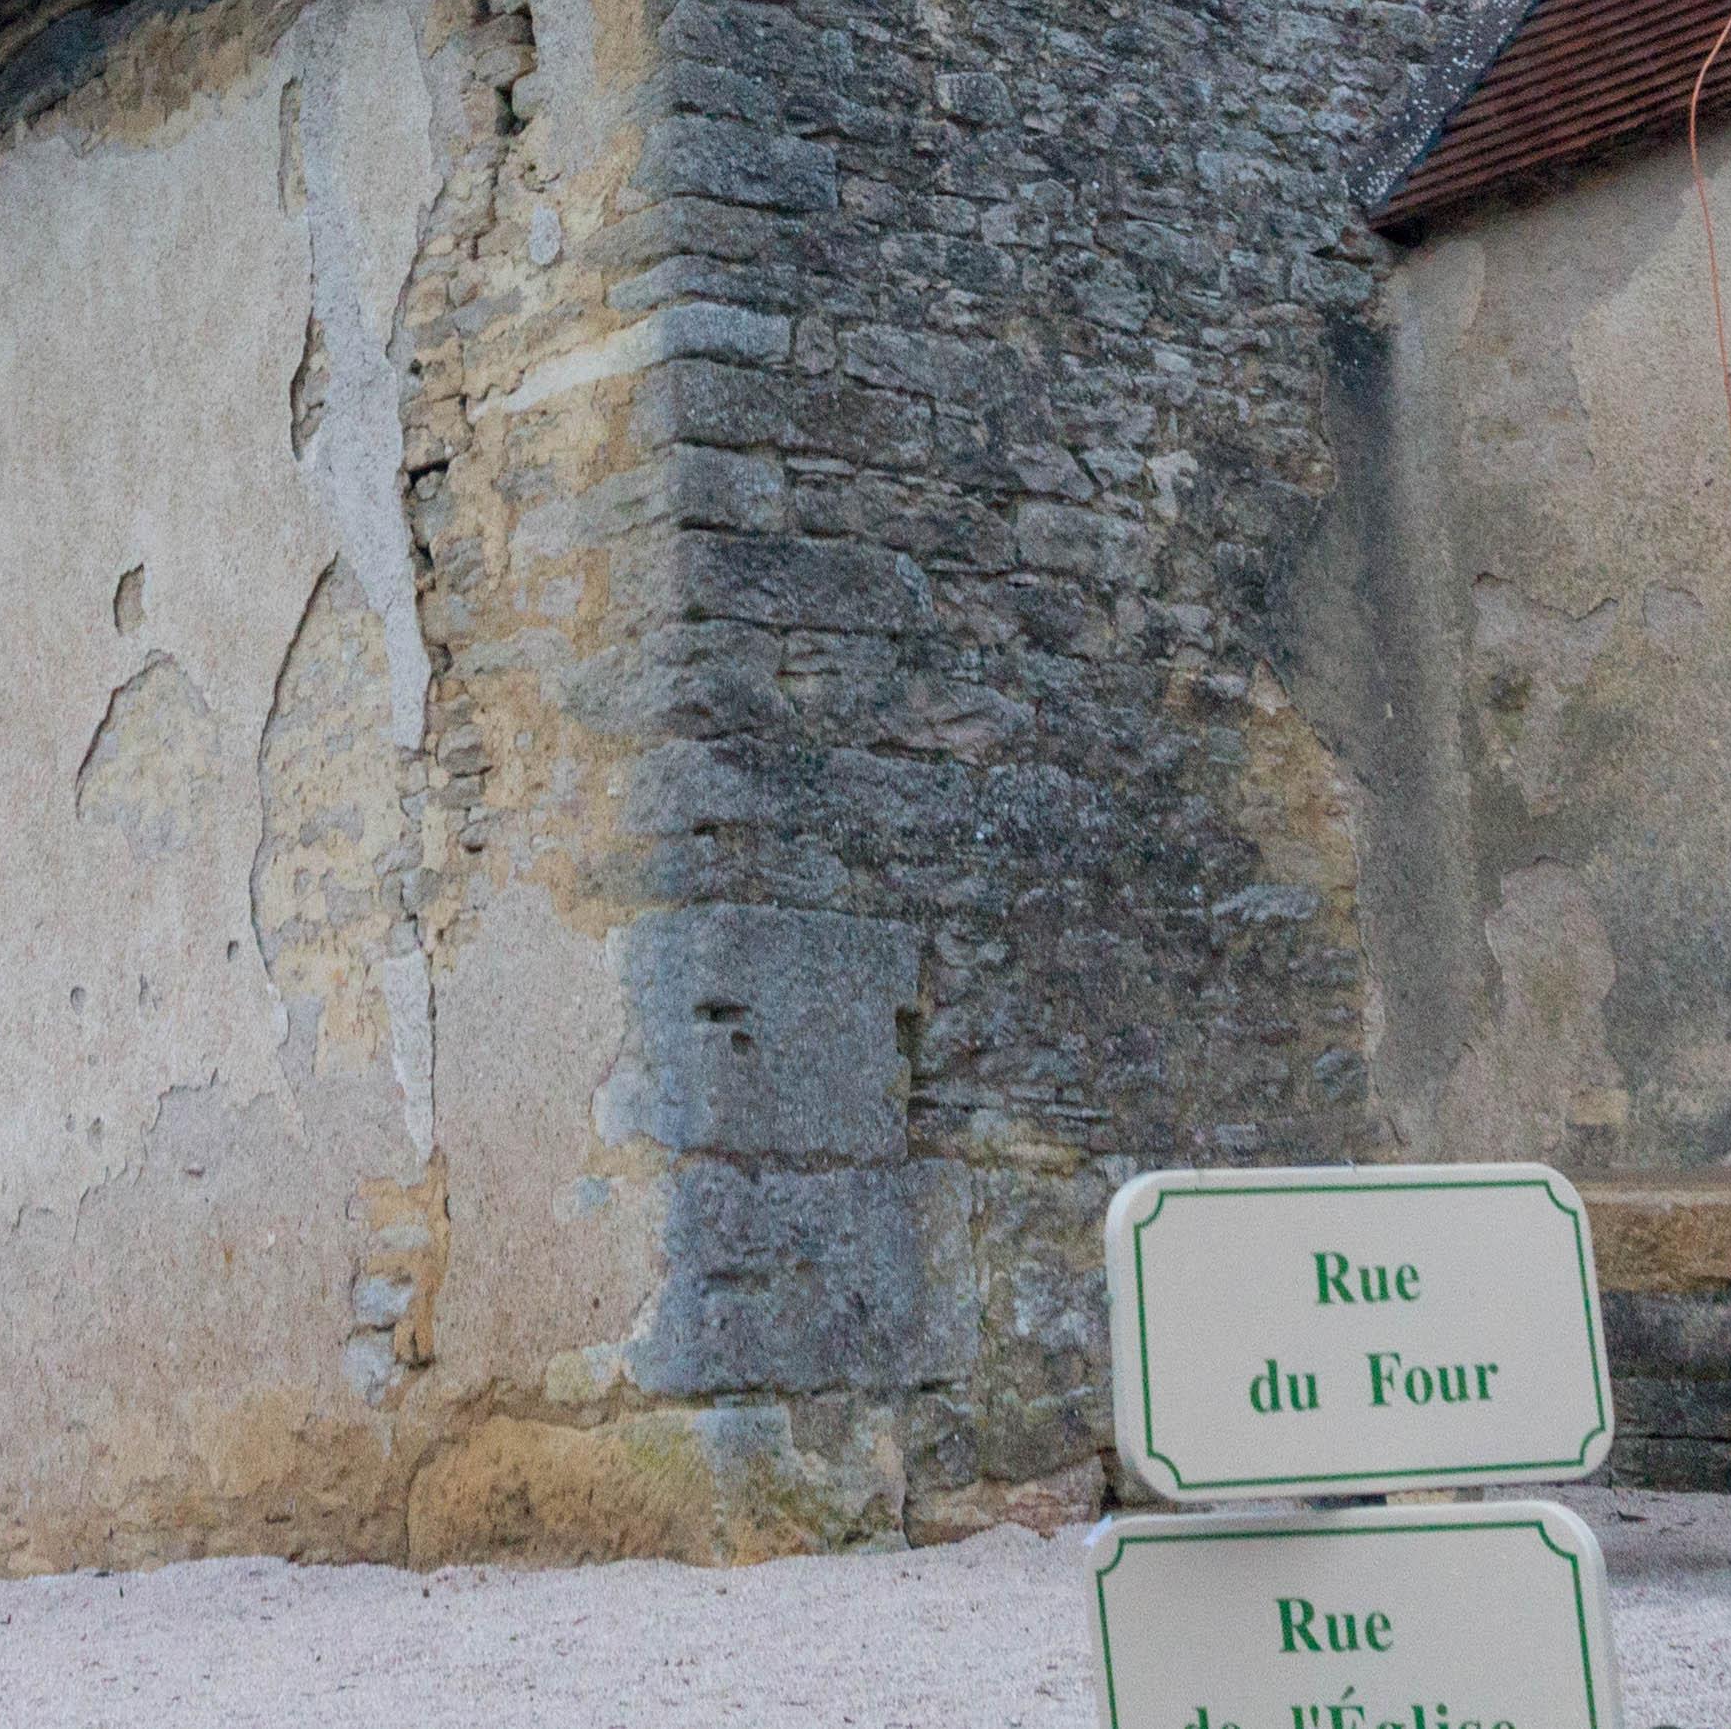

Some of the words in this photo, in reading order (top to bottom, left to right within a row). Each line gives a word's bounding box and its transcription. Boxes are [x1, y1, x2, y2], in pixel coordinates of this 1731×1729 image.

[1312, 1252, 1421, 1306] Rue
[1249, 1359, 1321, 1414] du
[1366, 1352, 1500, 1407] Four
[1275, 1598, 1395, 1654] Rue
